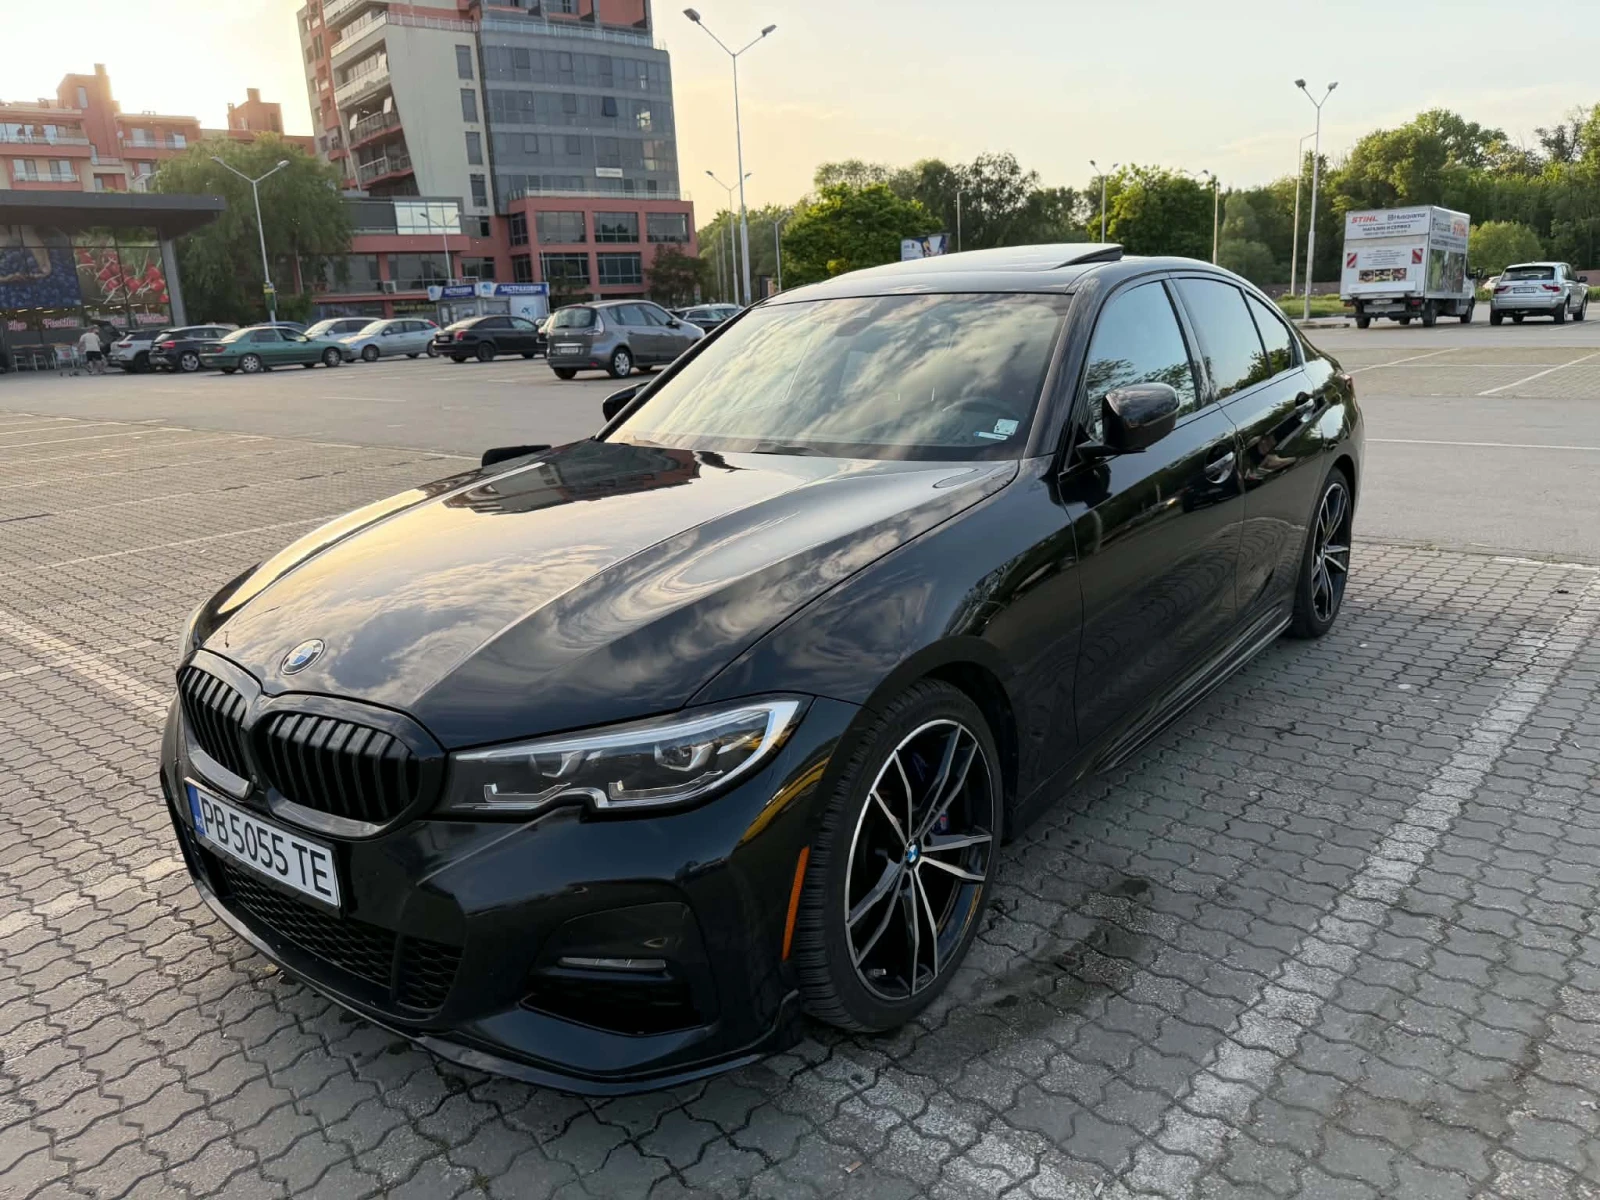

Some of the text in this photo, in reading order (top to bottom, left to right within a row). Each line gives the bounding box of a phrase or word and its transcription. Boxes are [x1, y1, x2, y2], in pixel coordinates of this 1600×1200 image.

[1351, 215, 1378, 223] STIHL
[200, 796, 332, 897] PB 5055 TE
